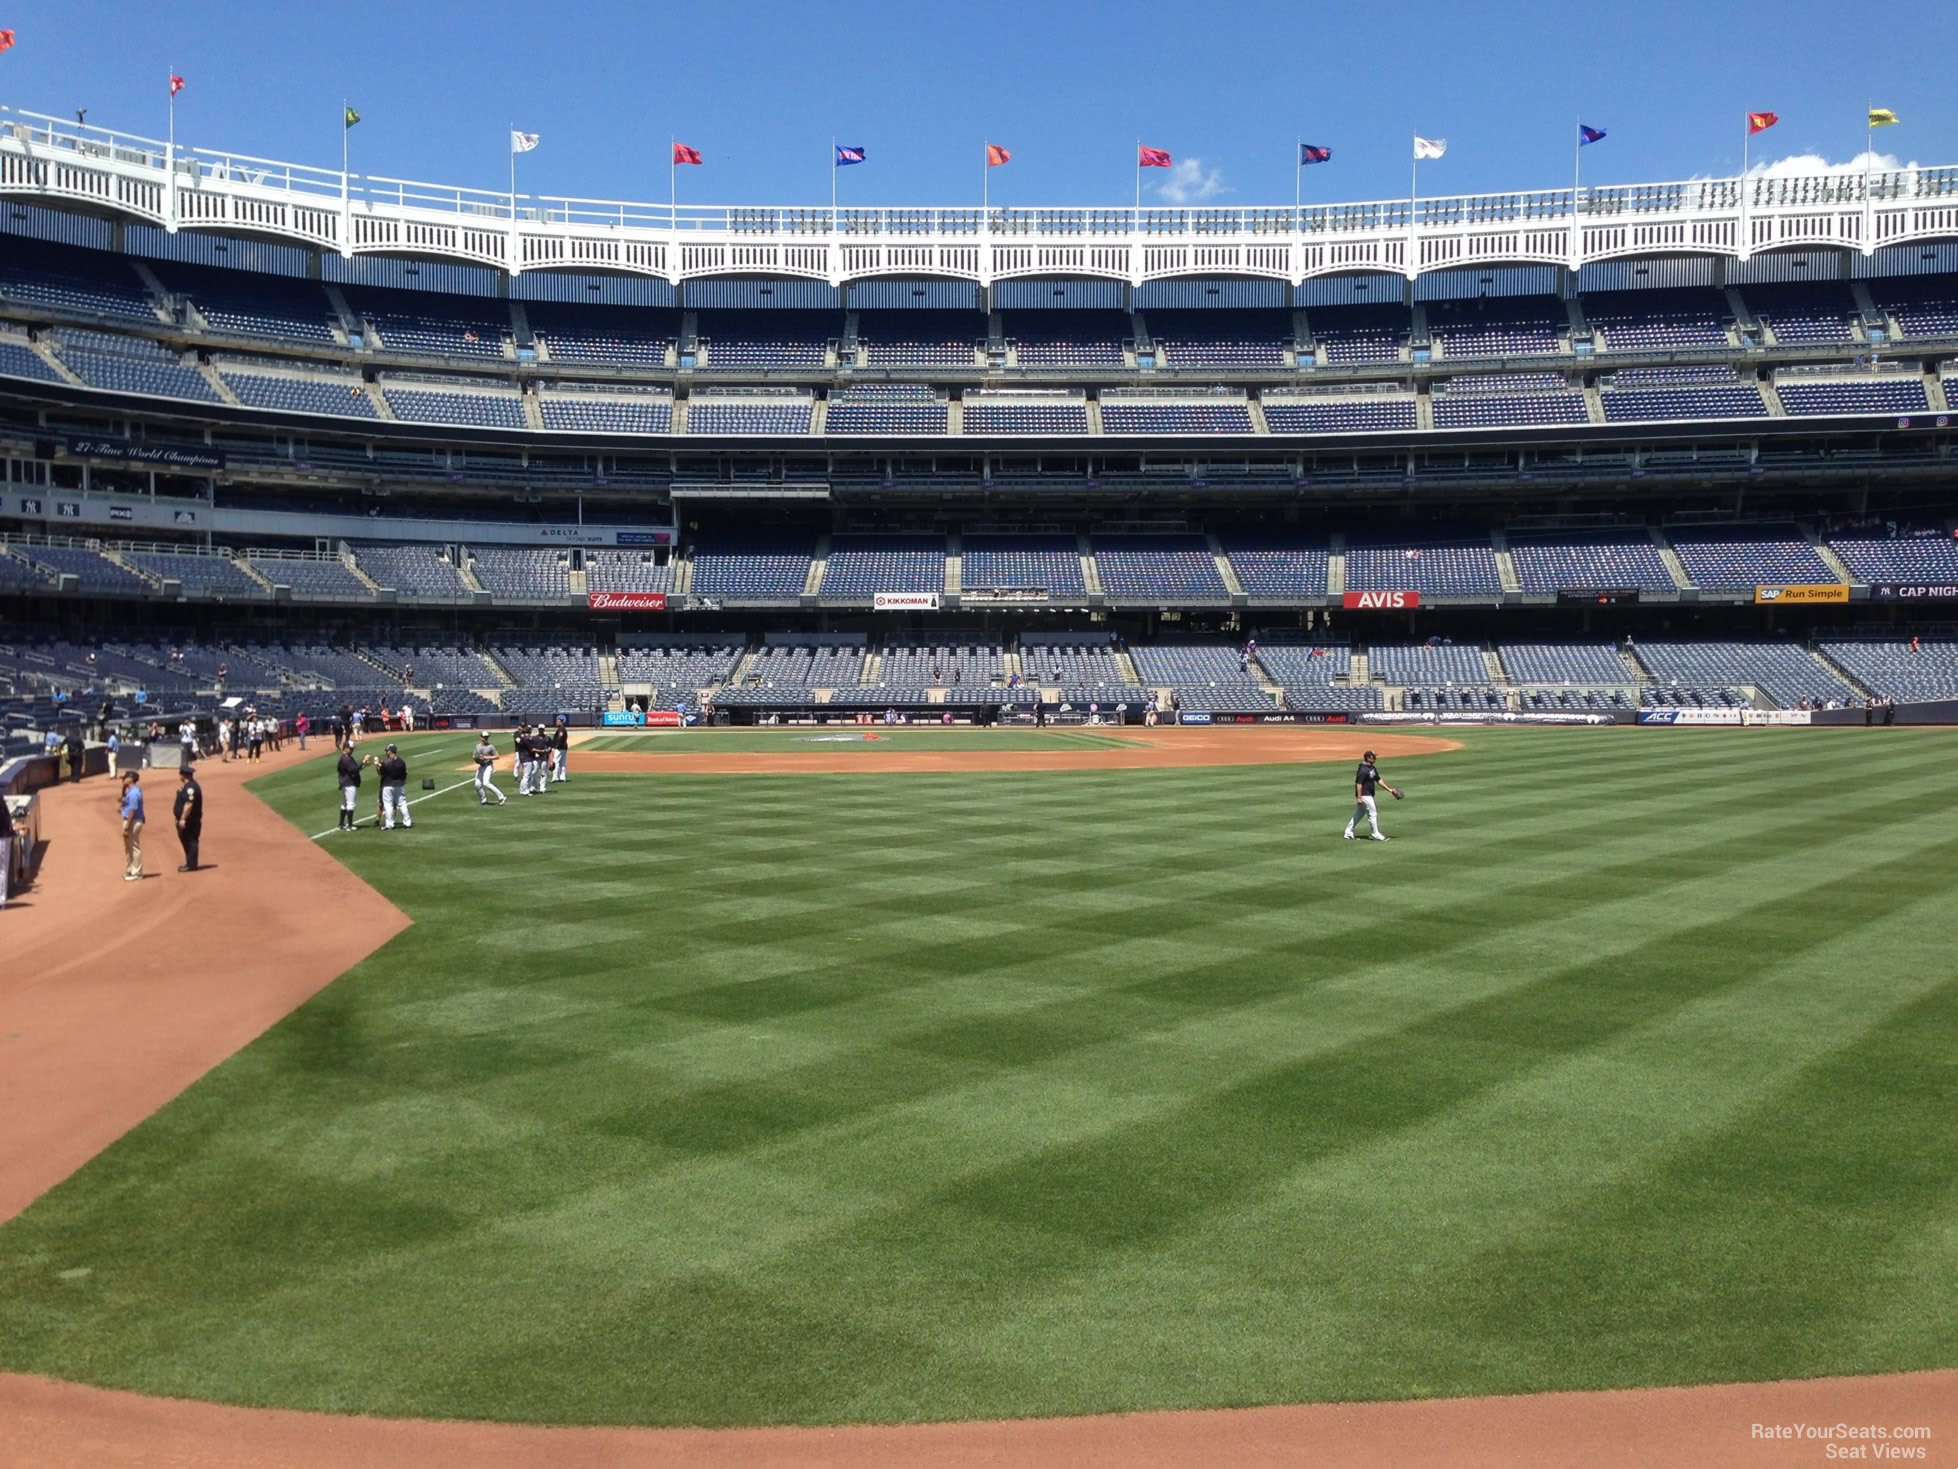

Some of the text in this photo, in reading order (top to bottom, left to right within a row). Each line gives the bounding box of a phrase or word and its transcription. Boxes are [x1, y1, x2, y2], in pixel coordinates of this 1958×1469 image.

[127, 447, 163, 459] World
[164, 452, 219, 465] Champions
[1760, 589, 1781, 599] SAP
[1785, 589, 1843, 599] Run Simple
[1899, 587, 1925, 597] CAP
[590, 593, 664, 608] Budweiser
[1358, 592, 1404, 608] AVIS
[1645, 713, 1672, 721] ACC
